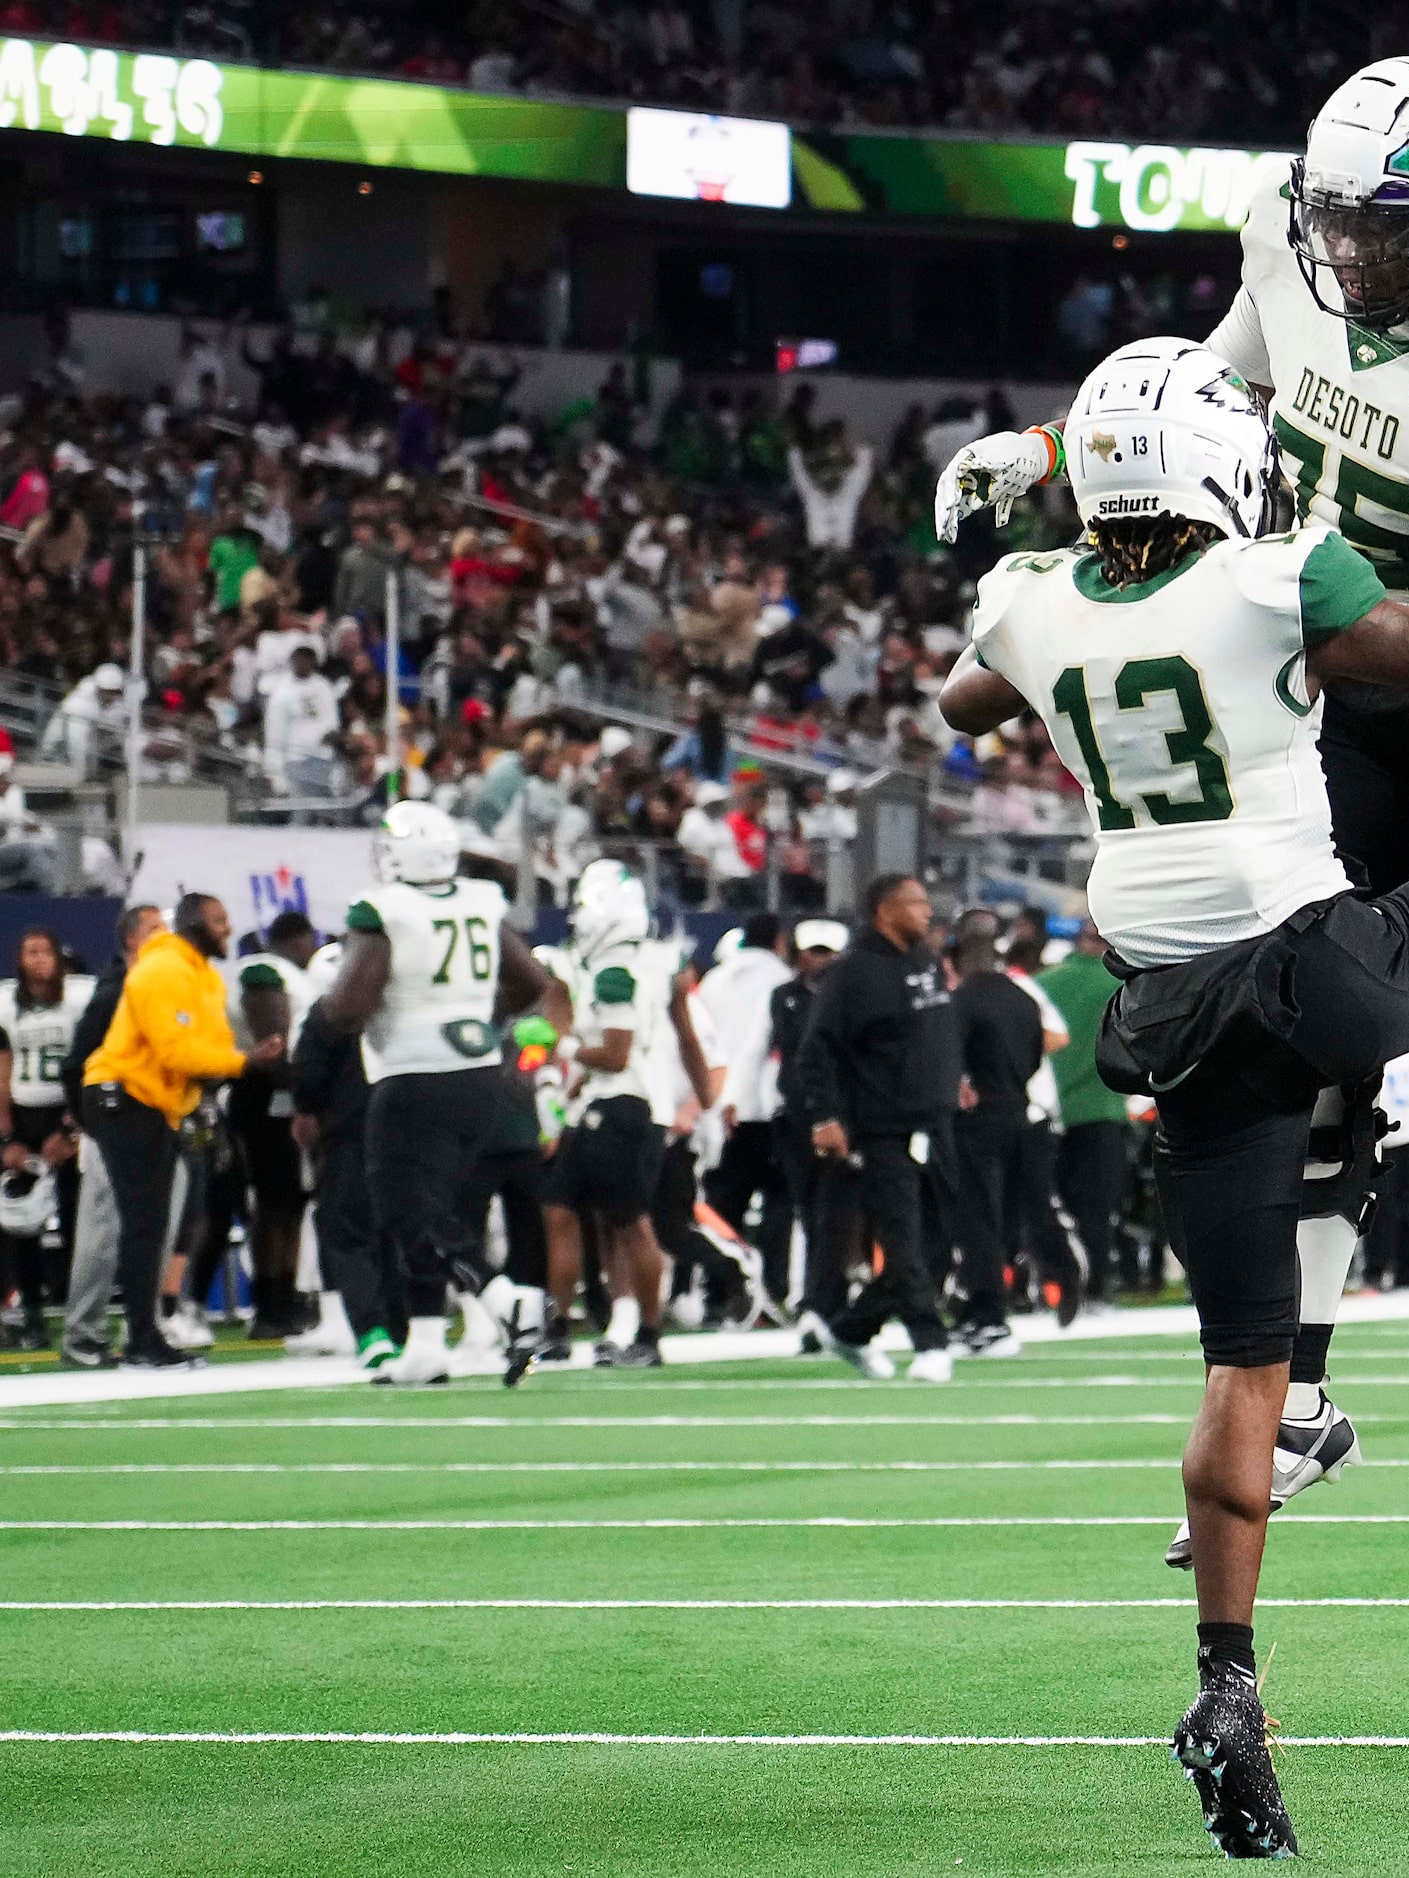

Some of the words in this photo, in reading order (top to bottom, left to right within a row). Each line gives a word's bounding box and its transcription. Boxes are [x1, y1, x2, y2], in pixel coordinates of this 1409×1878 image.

[1131, 435, 1148, 456] 13
[1292, 366, 1401, 461] DESOTO
[1098, 494, 1160, 514] schutt
[1050, 650, 1238, 832] 13
[431, 916, 491, 984] 76
